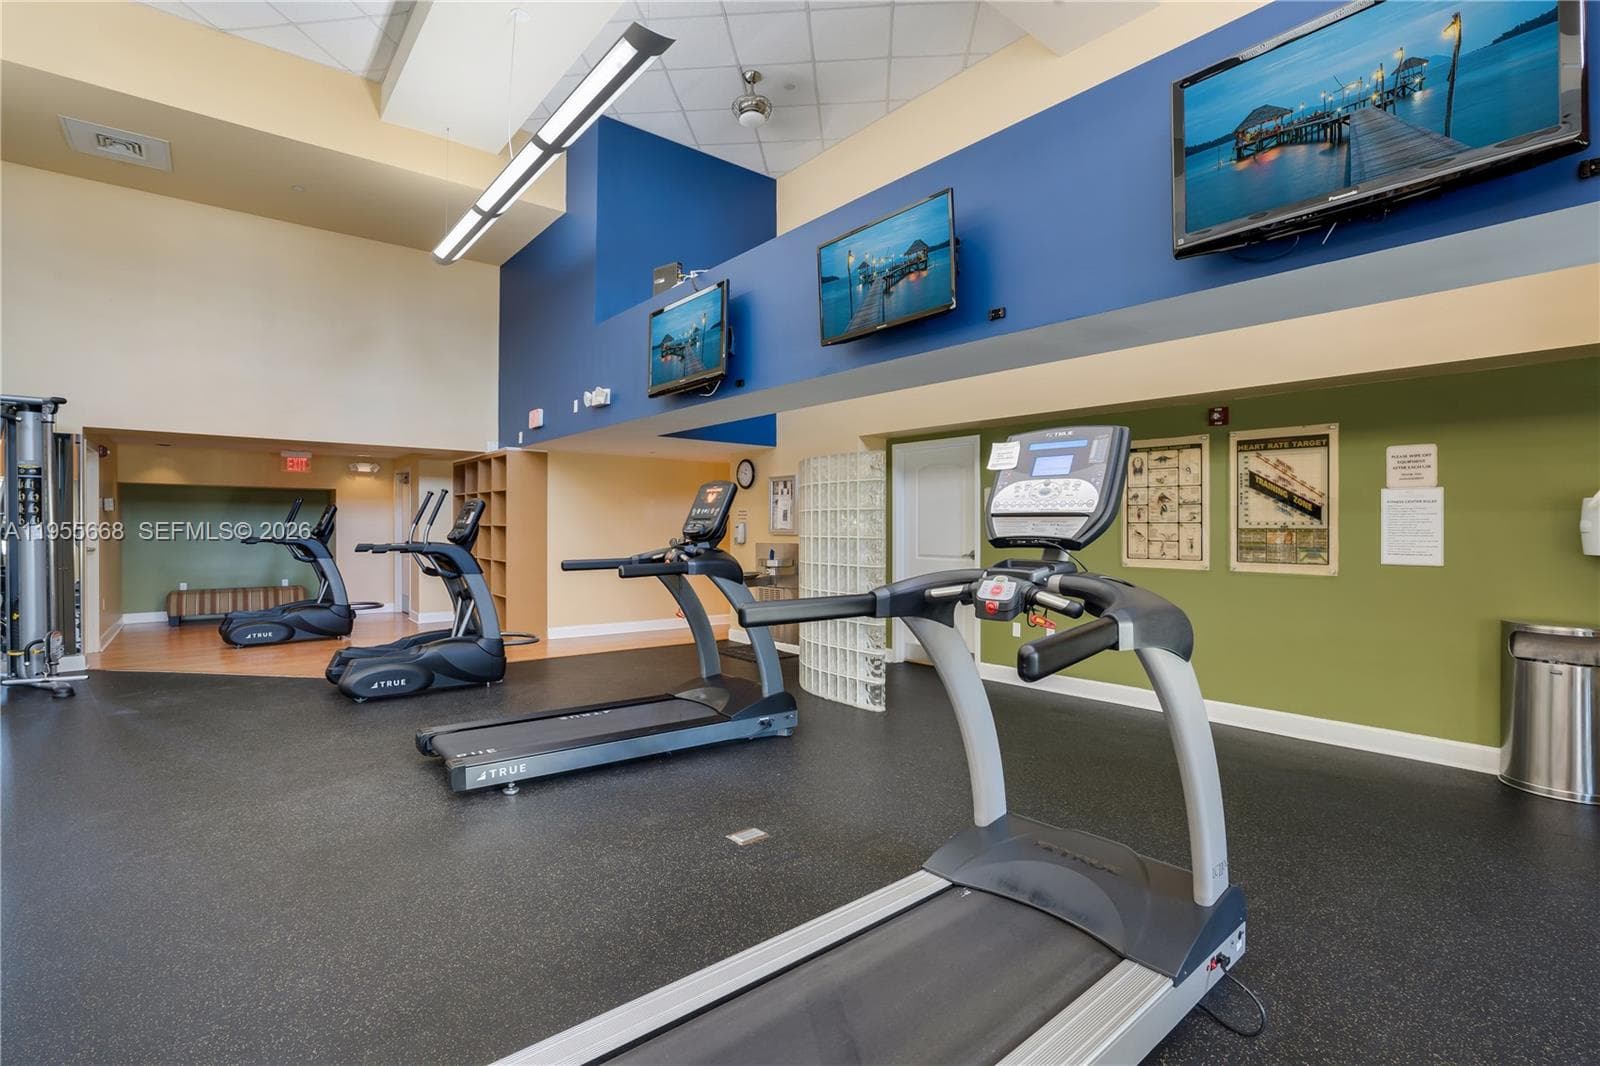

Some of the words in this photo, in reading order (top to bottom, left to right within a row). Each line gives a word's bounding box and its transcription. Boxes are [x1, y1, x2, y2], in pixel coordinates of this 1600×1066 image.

[1238, 443, 1265, 451] HEART
[1267, 441, 1290, 449] RATE
[1291, 439, 1328, 448] TARGET
[287, 457, 307, 471] EXIT
[1254, 475, 1288, 498] TRAINING
[1292, 495, 1313, 512] ZONE
[251, 631, 273, 639] TRUE
[377, 679, 406, 688] TRUE
[488, 763, 527, 779] TRUE
